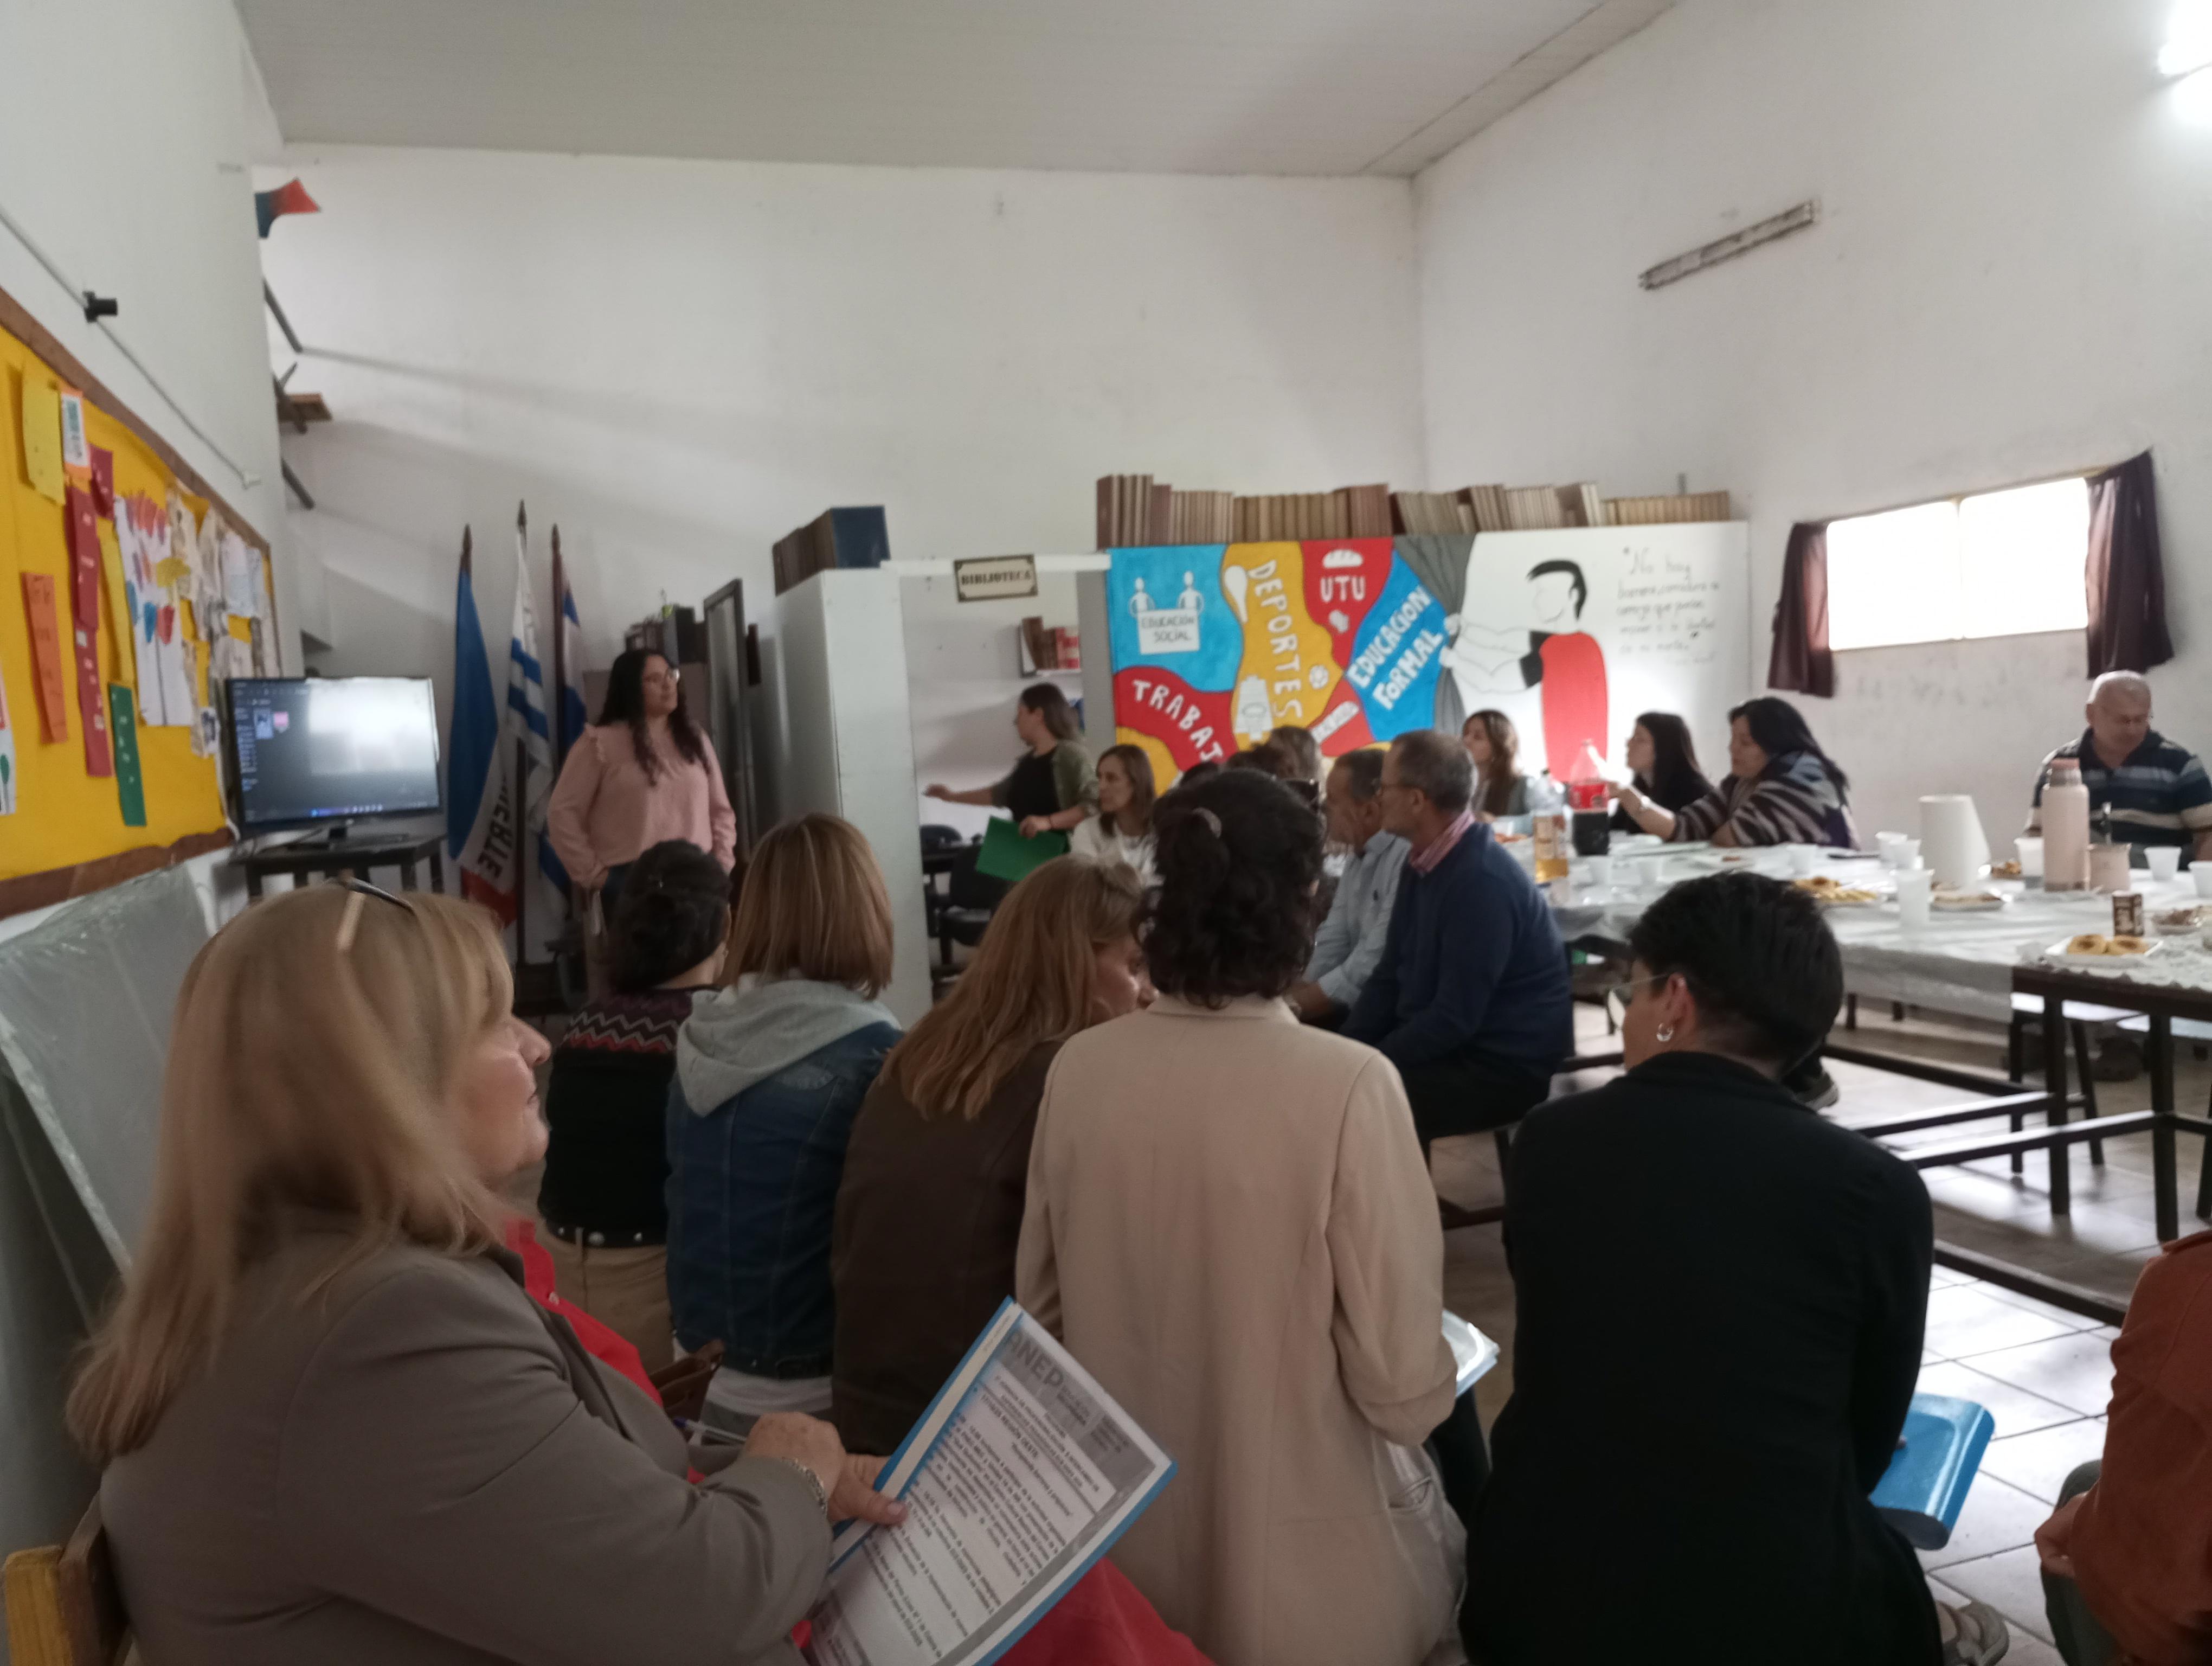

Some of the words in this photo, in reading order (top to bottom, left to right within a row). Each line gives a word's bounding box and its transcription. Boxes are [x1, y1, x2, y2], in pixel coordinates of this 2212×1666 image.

[961, 571, 1031, 585] BIBLIOTECA
[1320, 575, 1366, 603] UTU
[1246, 559, 1303, 719] DEPORTES
